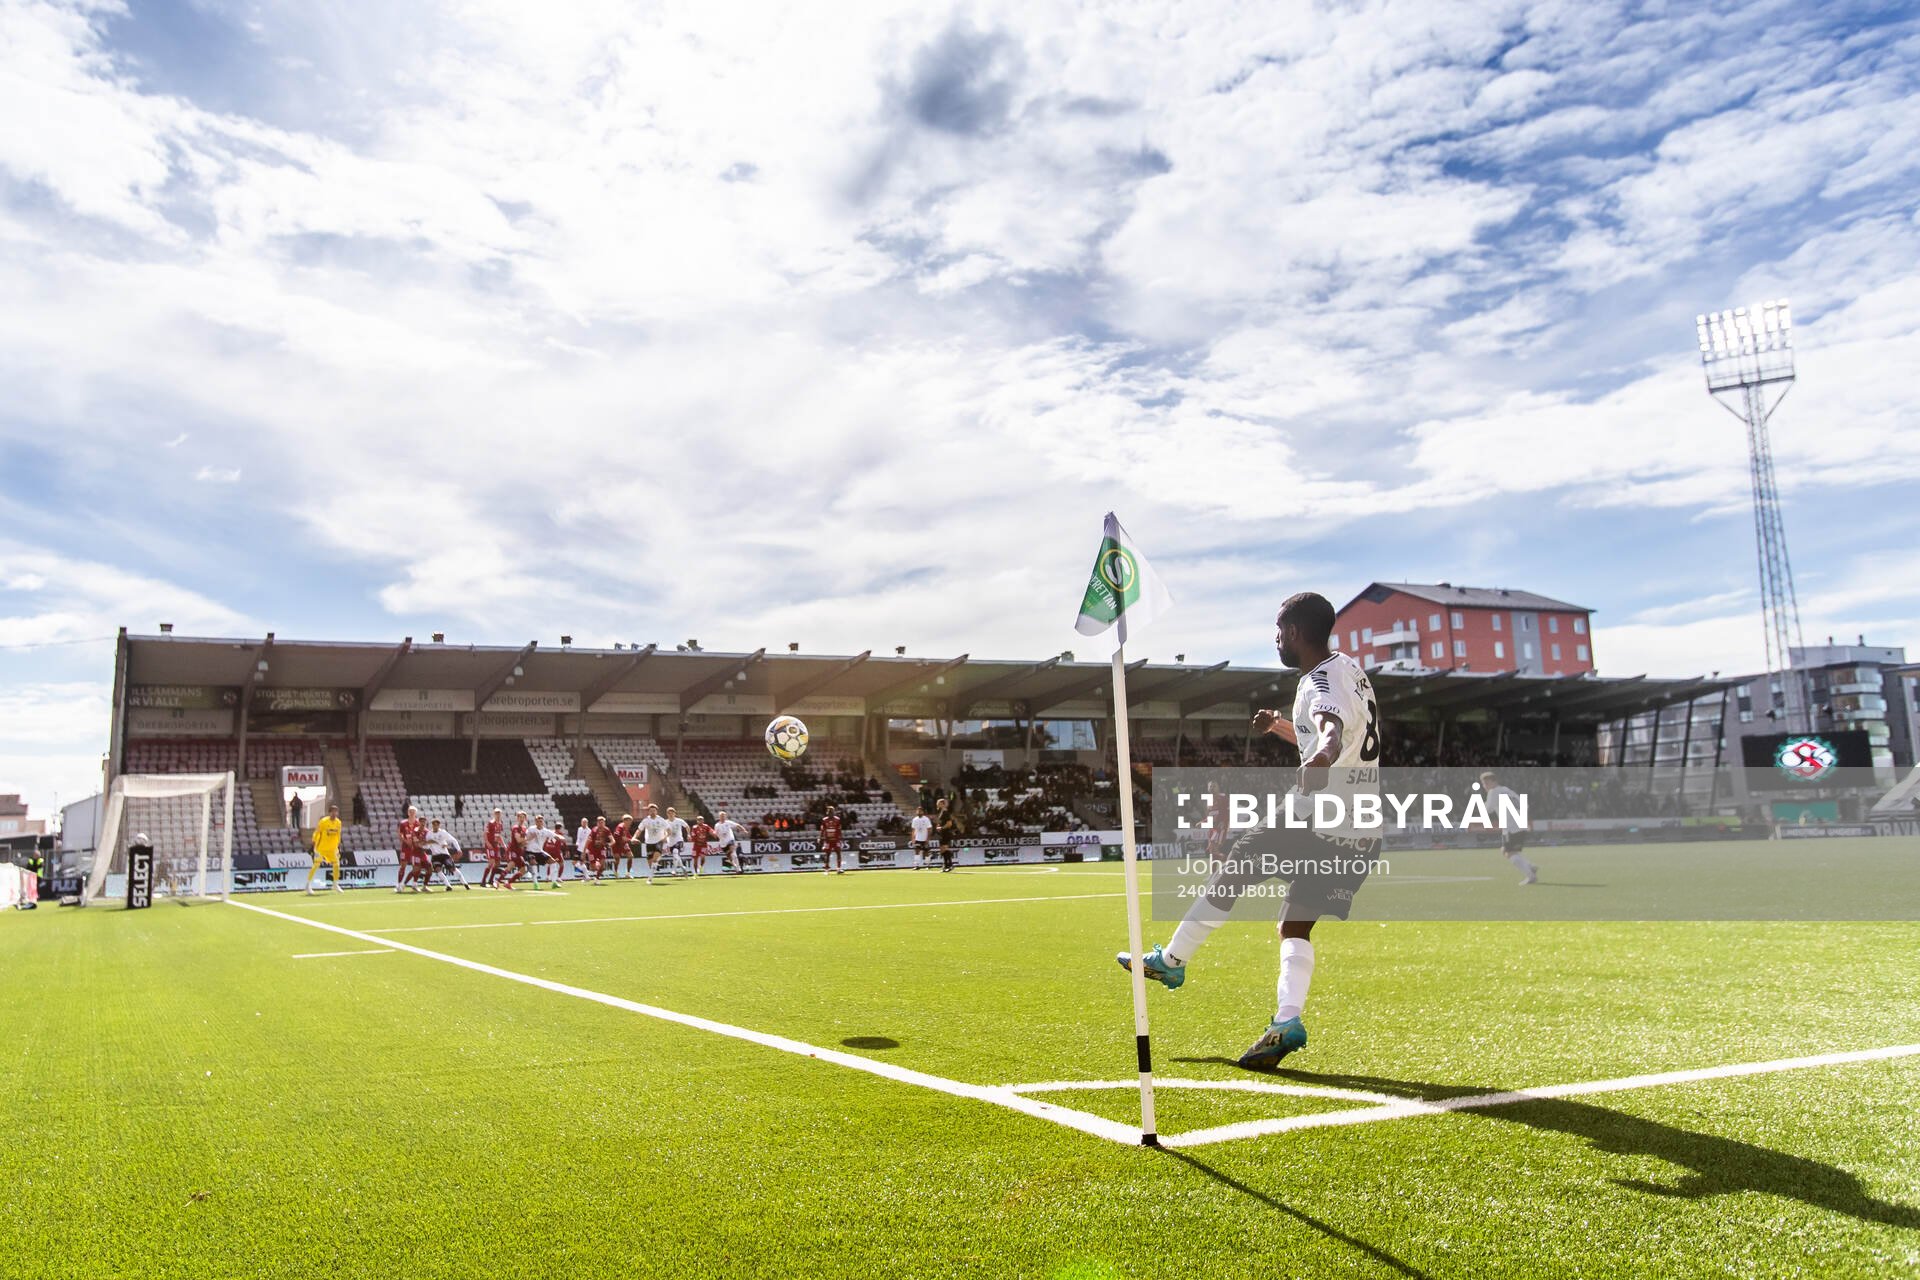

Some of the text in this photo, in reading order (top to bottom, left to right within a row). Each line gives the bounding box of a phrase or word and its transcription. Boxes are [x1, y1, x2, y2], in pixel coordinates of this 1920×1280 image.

[287, 772, 319, 782] MAXI
[617, 770, 644, 780] MAXI
[132, 853, 151, 907] SELECT
[252, 871, 288, 884] FRONT
[343, 868, 377, 880] FRONT
